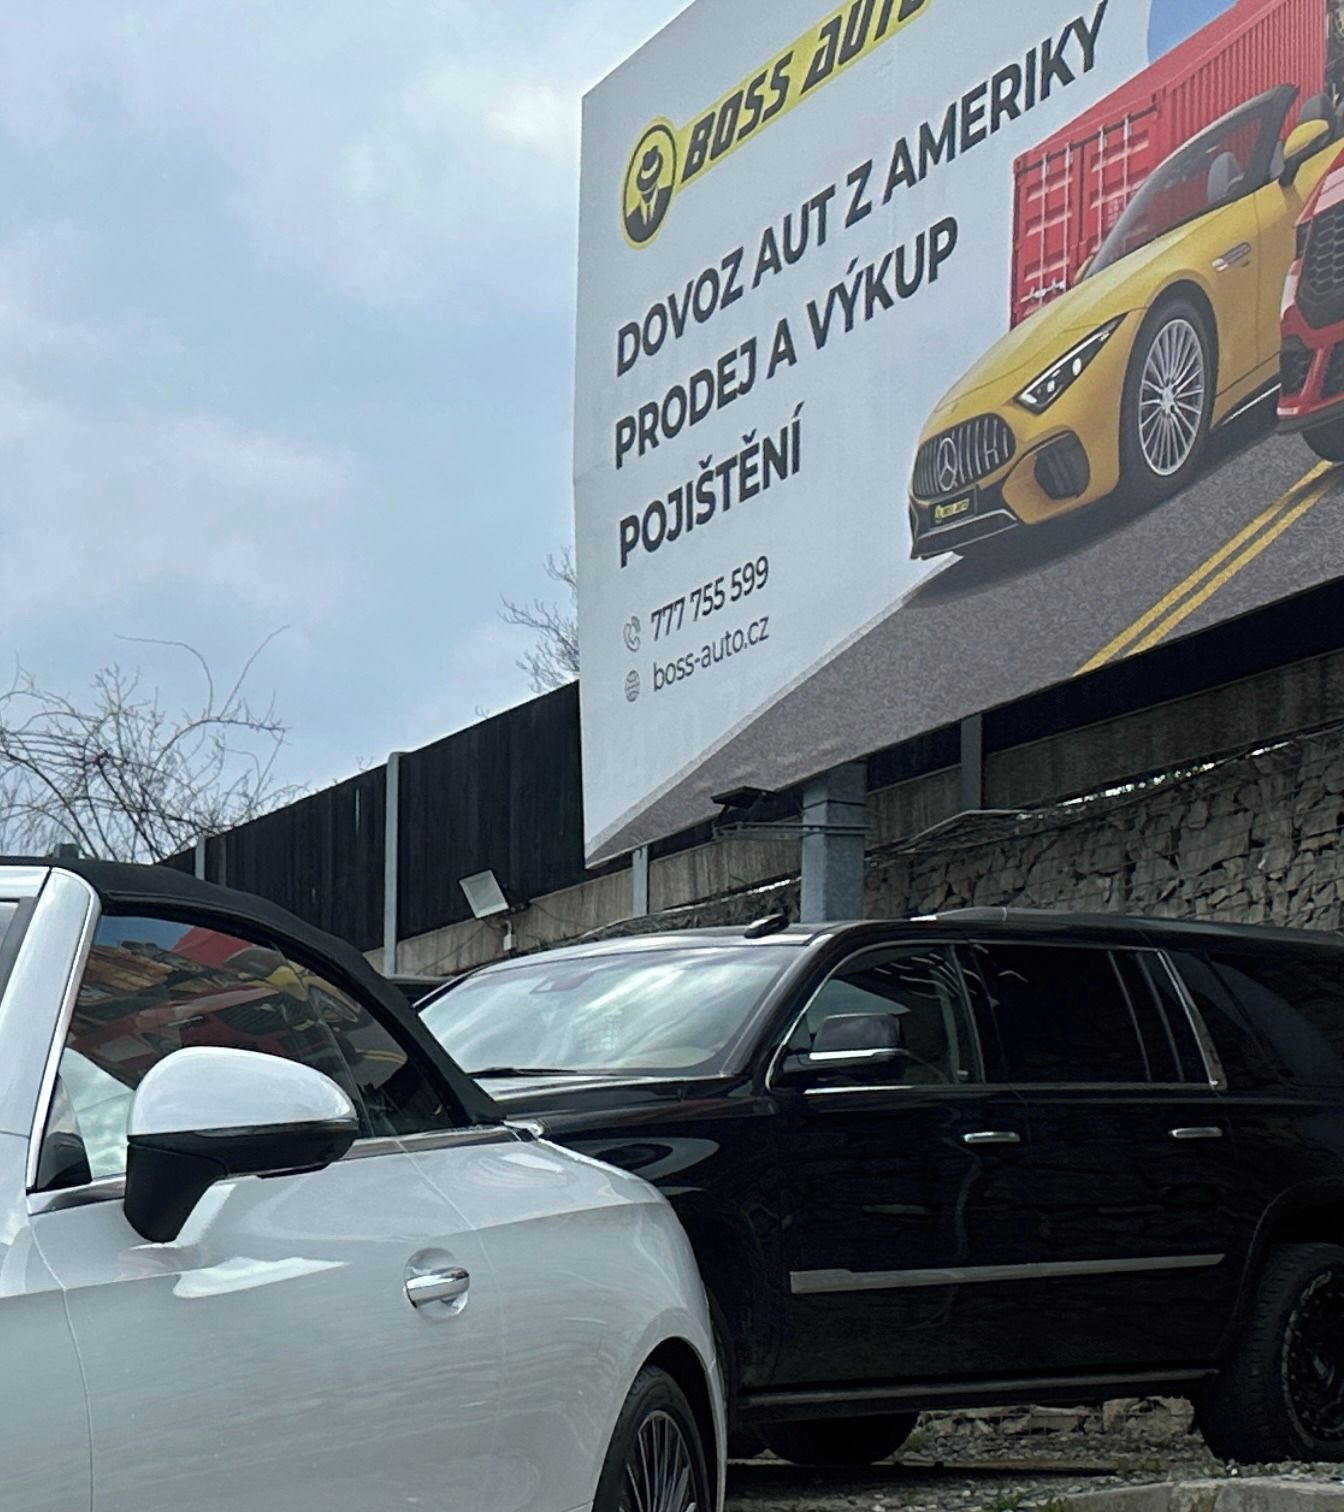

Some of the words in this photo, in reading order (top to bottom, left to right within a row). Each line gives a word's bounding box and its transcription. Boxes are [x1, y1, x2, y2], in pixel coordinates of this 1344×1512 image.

[617, 247, 744, 378] DOVOZ
[752, 184, 836, 289] AUT
[845, 159, 872, 228] Z
[883, 0, 1109, 203] AMERIKY
[681, 50, 794, 183] BOSS
[616, 337, 757, 470] PRODEJ
[766, 318, 797, 380] A
[806, 216, 958, 350] VÝKUP
[620, 401, 805, 568] POJIŠTĚNÍ
[651, 597, 685, 642] 777
[690, 577, 725, 622] 755
[730, 555, 769, 602] 599
[653, 616, 769, 692] boss-auto.cz
